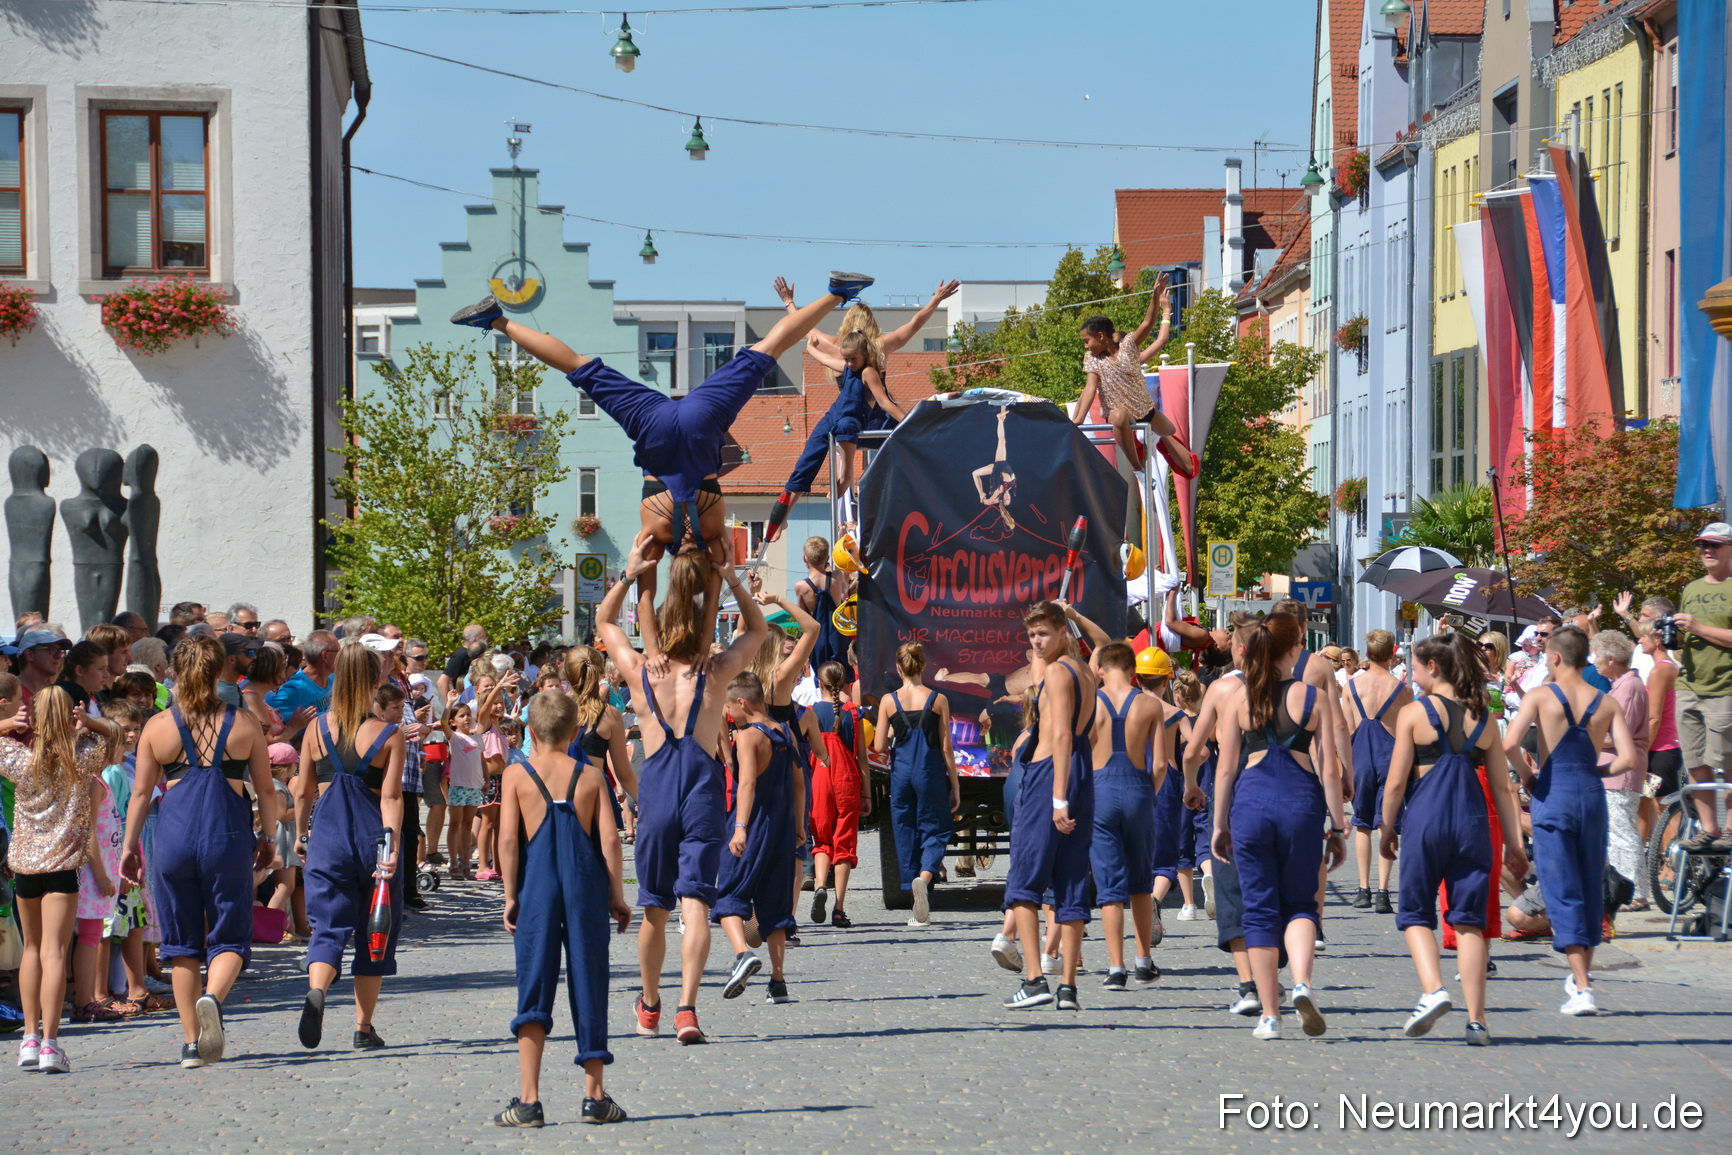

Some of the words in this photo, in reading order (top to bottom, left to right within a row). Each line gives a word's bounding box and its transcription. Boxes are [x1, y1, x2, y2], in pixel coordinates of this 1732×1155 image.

[931, 606, 1004, 619] Neumarkt
[935, 628, 1010, 644] MACHEN
[958, 648, 1022, 664] STARK
